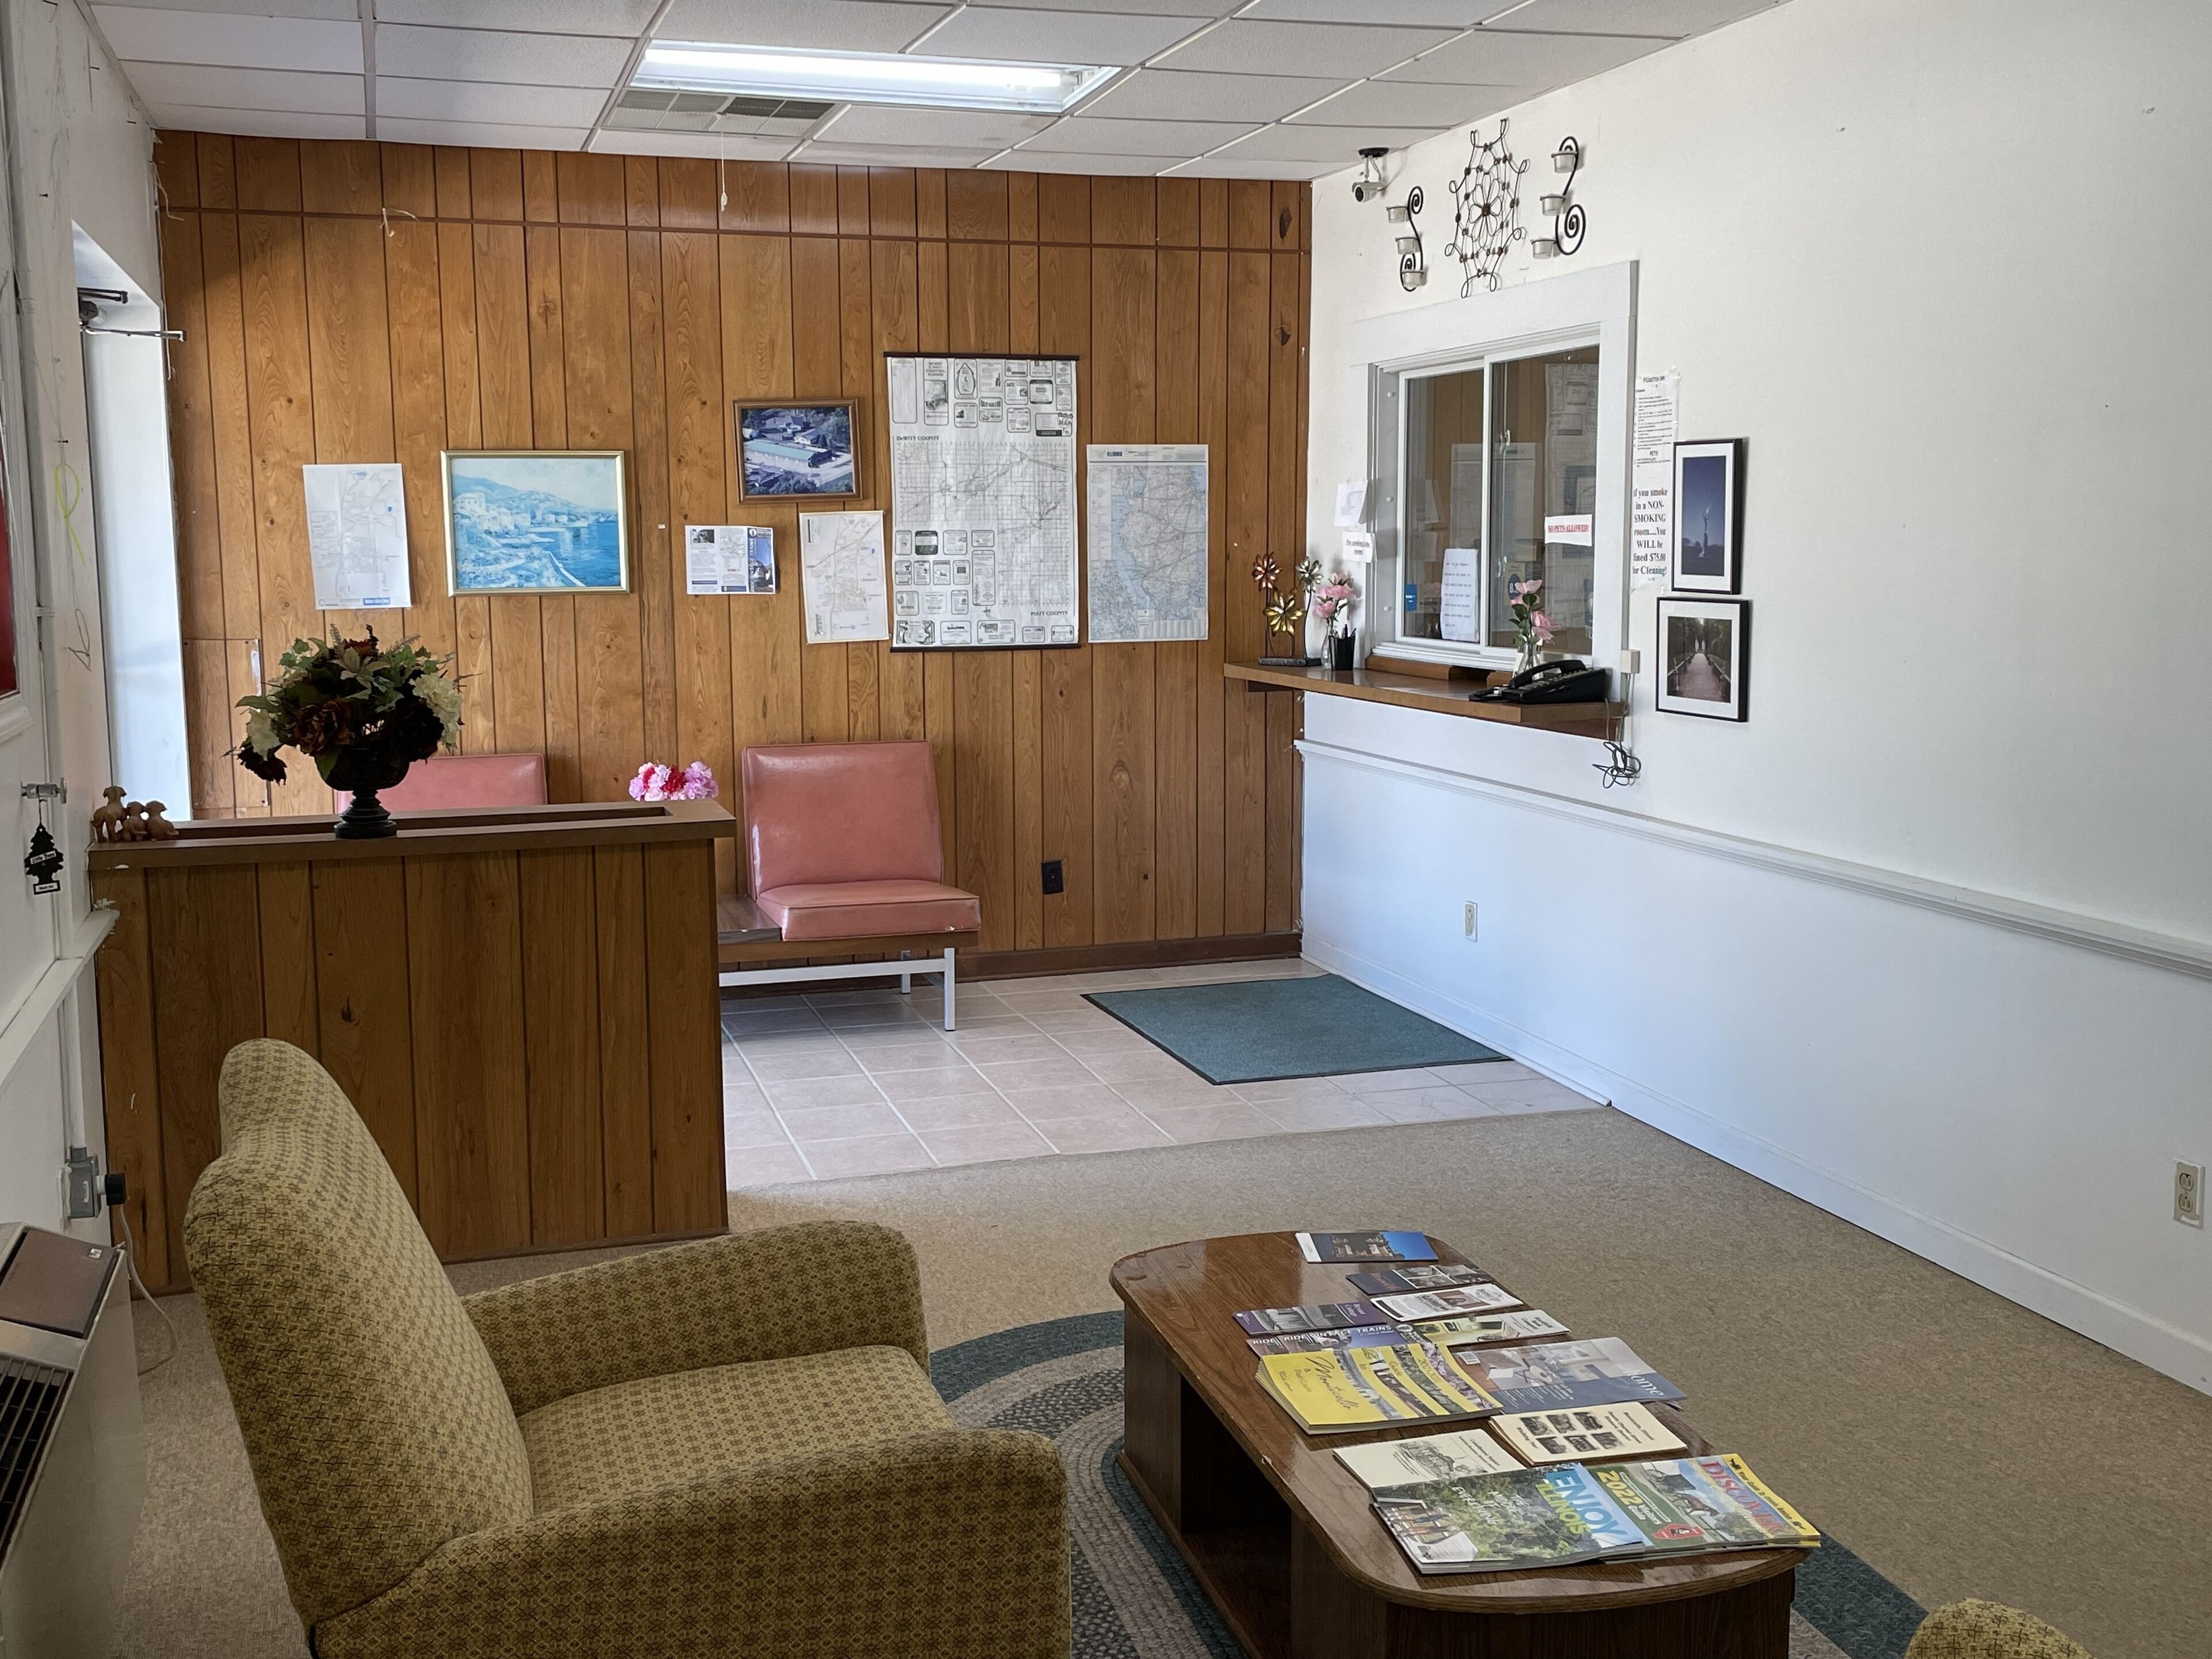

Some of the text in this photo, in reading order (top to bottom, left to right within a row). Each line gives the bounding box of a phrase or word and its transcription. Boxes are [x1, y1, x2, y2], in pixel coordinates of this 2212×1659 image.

[1638, 490, 1649, 499] you
[1650, 488, 1668, 497] smoke
[1647, 501, 1665, 509] NON-
[1634, 514, 1666, 523] SMOKING
[1637, 540, 1657, 548] WILL
[1633, 552, 1648, 562] fined
[1641, 566, 1667, 577] Cleaning!
[1284, 1334, 1306, 1342] RIDE
[1357, 1325, 1392, 1334] TRAINS
[1305, 1357, 1359, 1410] Monticello
[1508, 1494, 1529, 1507] THE
[1545, 1468, 1628, 1536] ENJOY
[1597, 1469, 1641, 1506] 2022
[1639, 1504, 1662, 1525] Visitors
[1451, 1486, 1501, 1525] EVERYTHING
[1535, 1483, 1591, 1535] ILLINOIS
[1628, 1505, 1647, 1520] Guide
